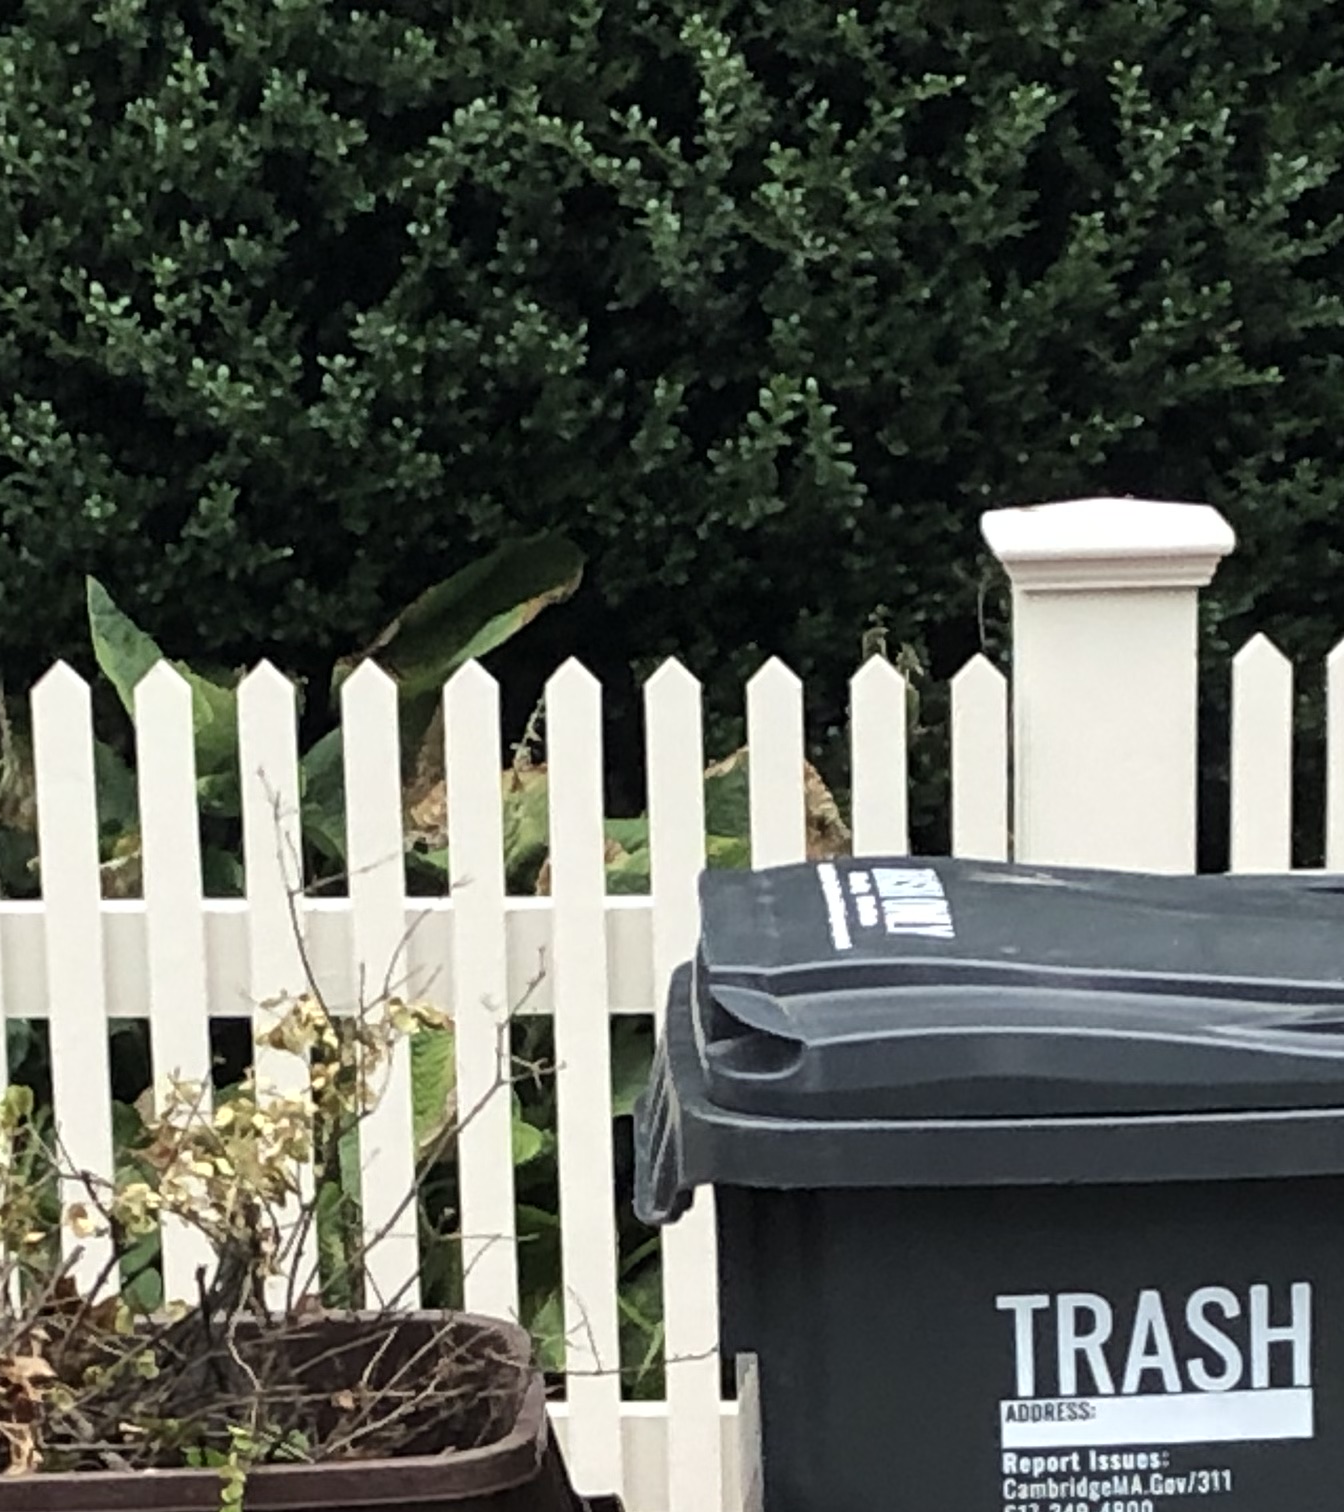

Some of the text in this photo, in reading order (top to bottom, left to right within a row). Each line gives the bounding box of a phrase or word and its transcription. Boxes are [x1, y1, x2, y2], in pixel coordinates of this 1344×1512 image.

[996, 1282, 1312, 1397] TRASH
[1005, 1402, 1096, 1423] ADDRESS:
[1003, 1449, 1170, 1477] Report Issues:
[1003, 1469, 1232, 1501] CambridgeMA.Gov/311
